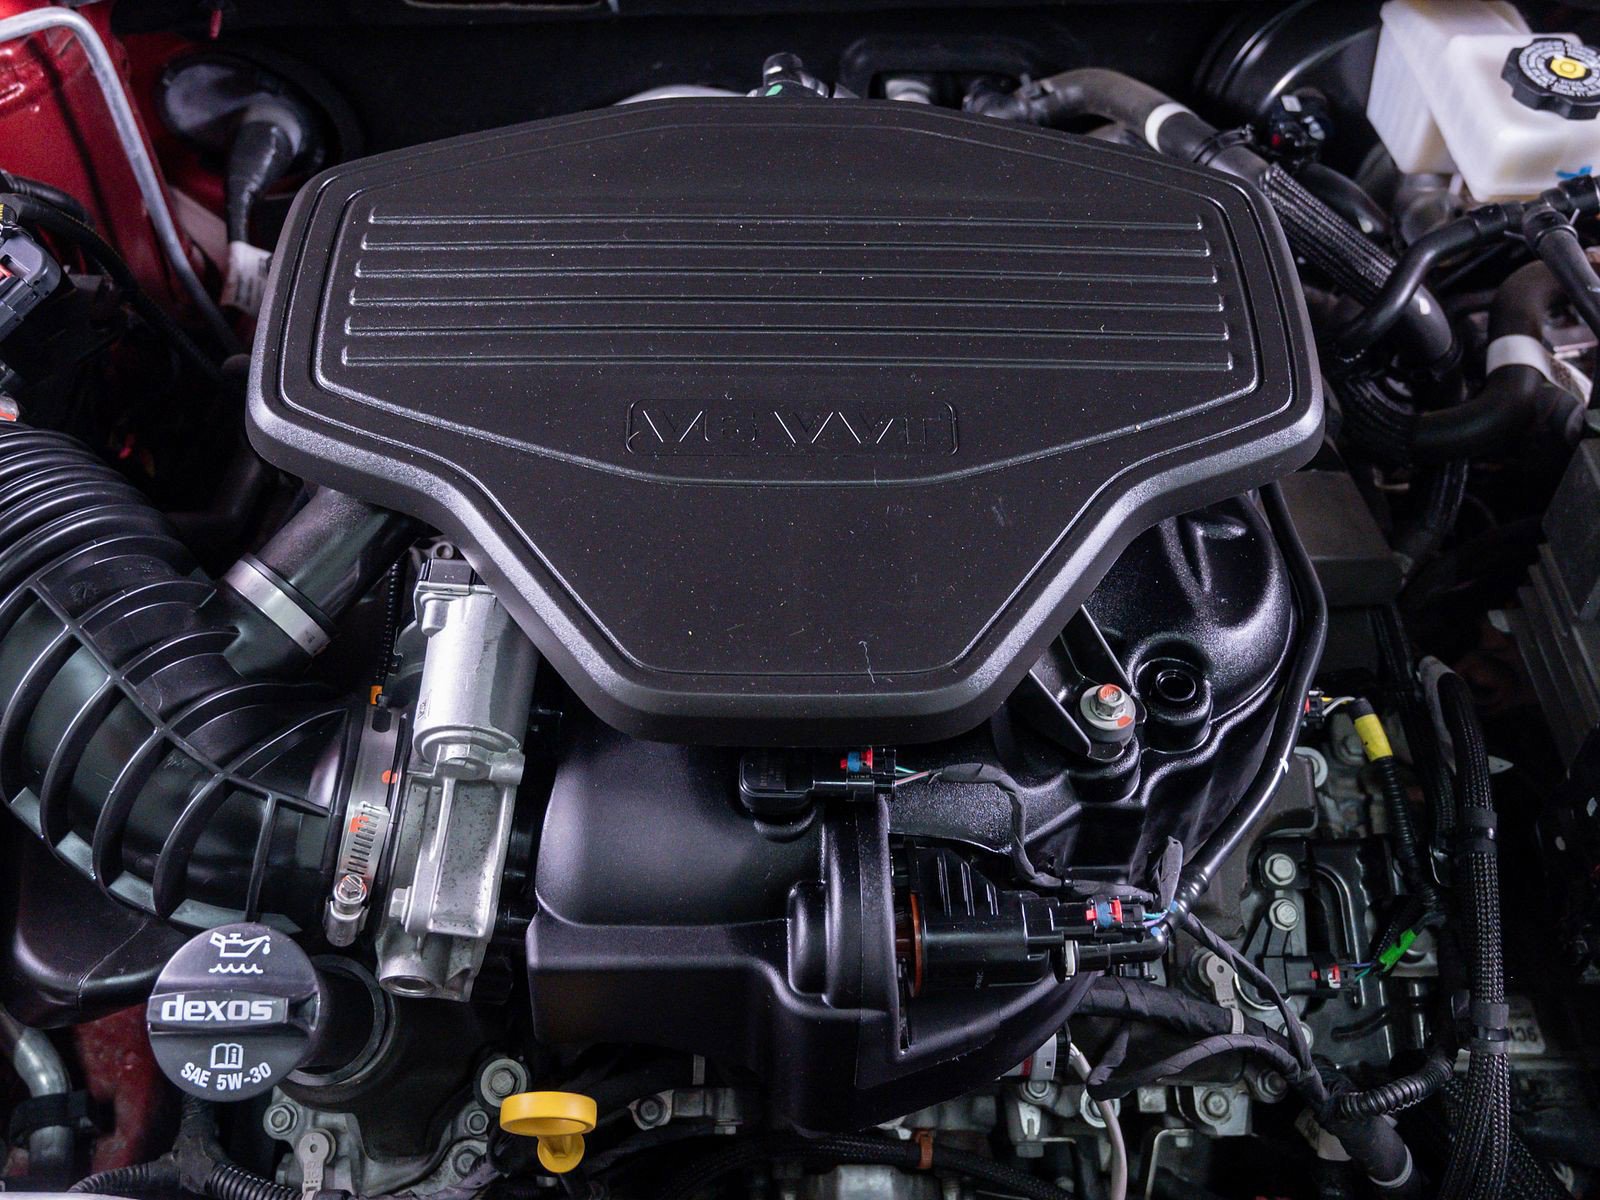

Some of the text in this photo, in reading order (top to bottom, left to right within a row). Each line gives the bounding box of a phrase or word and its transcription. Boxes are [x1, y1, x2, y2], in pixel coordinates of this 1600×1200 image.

[642, 408, 943, 444] V6 VVT
[161, 994, 273, 1021] dexos
[180, 1062, 272, 1090] SAE 5W-30
